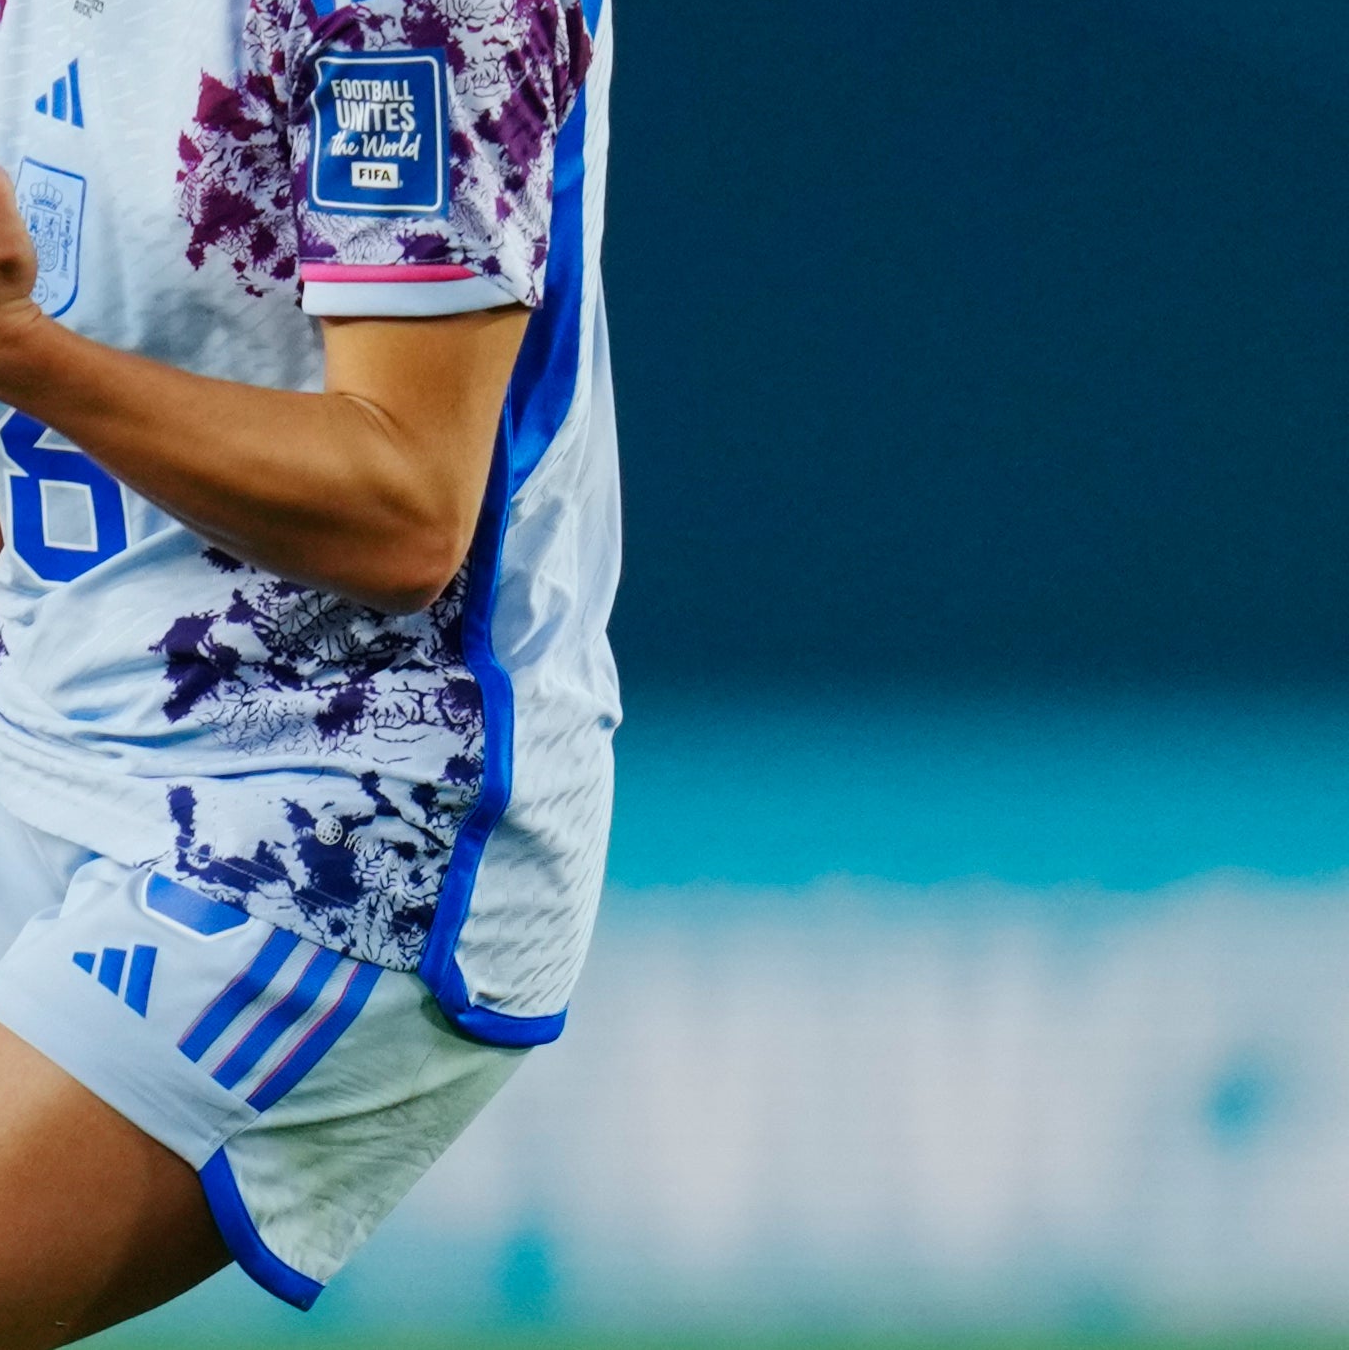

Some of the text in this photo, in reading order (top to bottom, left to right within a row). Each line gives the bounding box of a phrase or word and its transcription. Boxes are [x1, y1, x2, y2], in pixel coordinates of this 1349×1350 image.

[331, 79, 414, 101] FOOTBALL
[335, 100, 416, 133] UNITES
[330, 130, 422, 161] the World
[358, 167, 392, 182] FIFA
